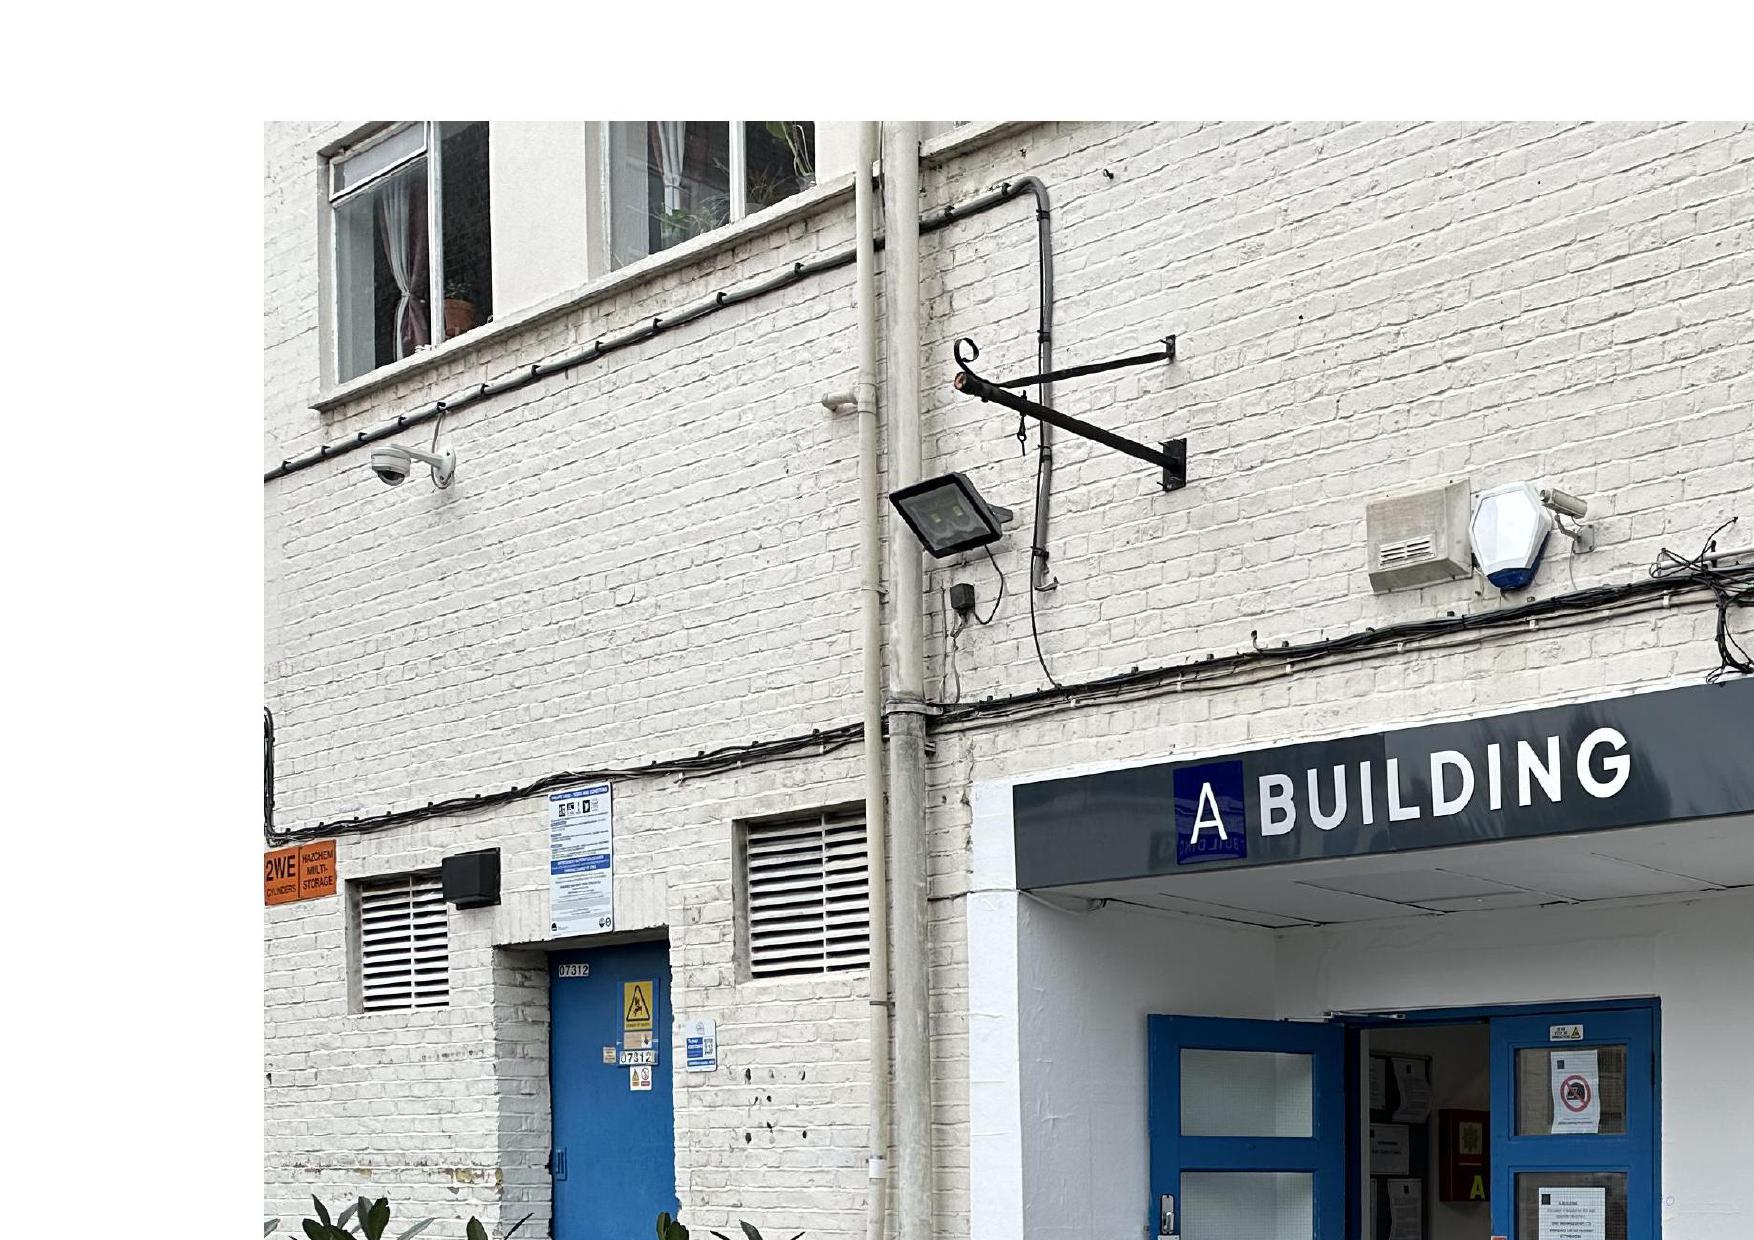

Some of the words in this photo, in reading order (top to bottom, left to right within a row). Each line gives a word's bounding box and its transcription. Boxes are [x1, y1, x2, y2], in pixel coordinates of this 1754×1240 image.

[1190, 782, 1228, 845] A
[1258, 727, 1632, 837] BUILDING
[302, 850, 333, 864] HAZCHEM
[265, 855, 296, 881] 2WE
[302, 875, 333, 890] STORAGE
[266, 884, 297, 898] CYLINDERS
[560, 965, 588, 976] 07312
[1470, 1175, 1485, 1200] A
